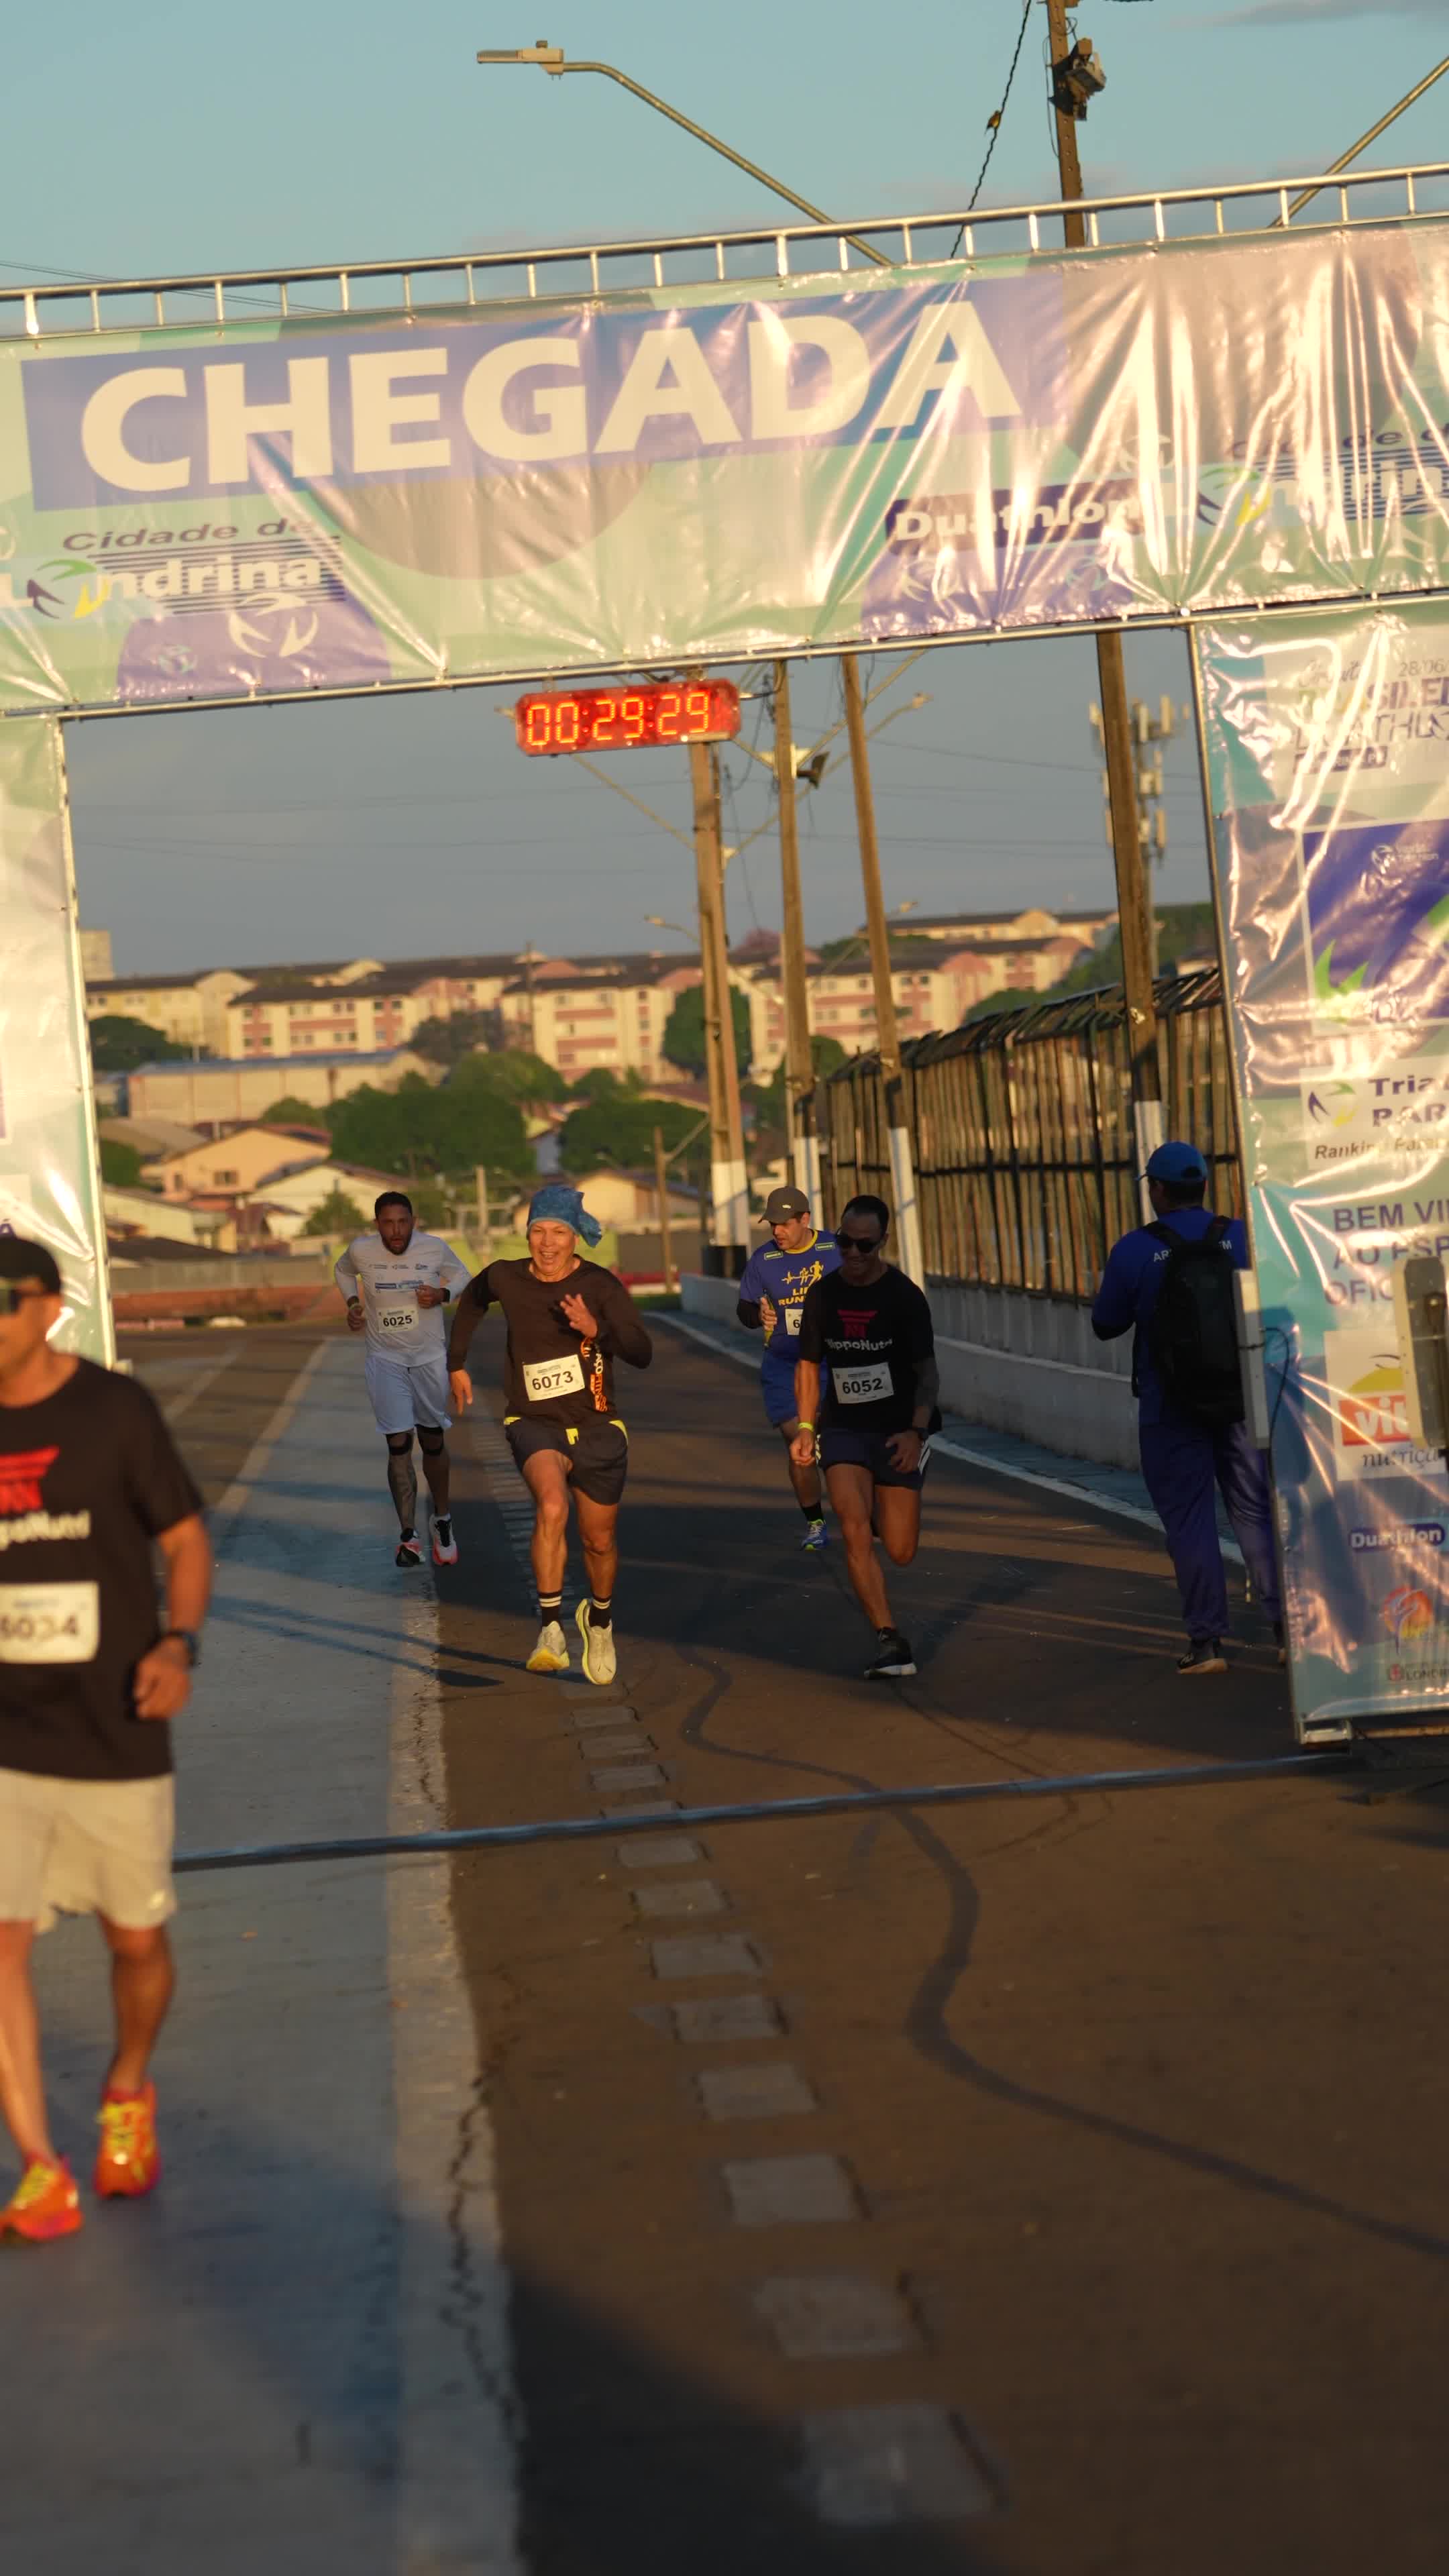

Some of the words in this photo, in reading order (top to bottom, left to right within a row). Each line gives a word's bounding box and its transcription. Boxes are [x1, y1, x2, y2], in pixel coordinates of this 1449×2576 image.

[80, 299, 1022, 492] CHEGADA
[896, 496, 1142, 541] Duthlon
[63, 523, 239, 551] Cidade
[527, 690, 708, 746] 00:29:29
[1333, 1203, 1404, 1232] BEM
[1413, 1199, 1449, 1224] VI
[382, 1315, 413, 1328] 6025
[532, 1370, 574, 1391] 6073
[842, 1377, 883, 1395] 6052
